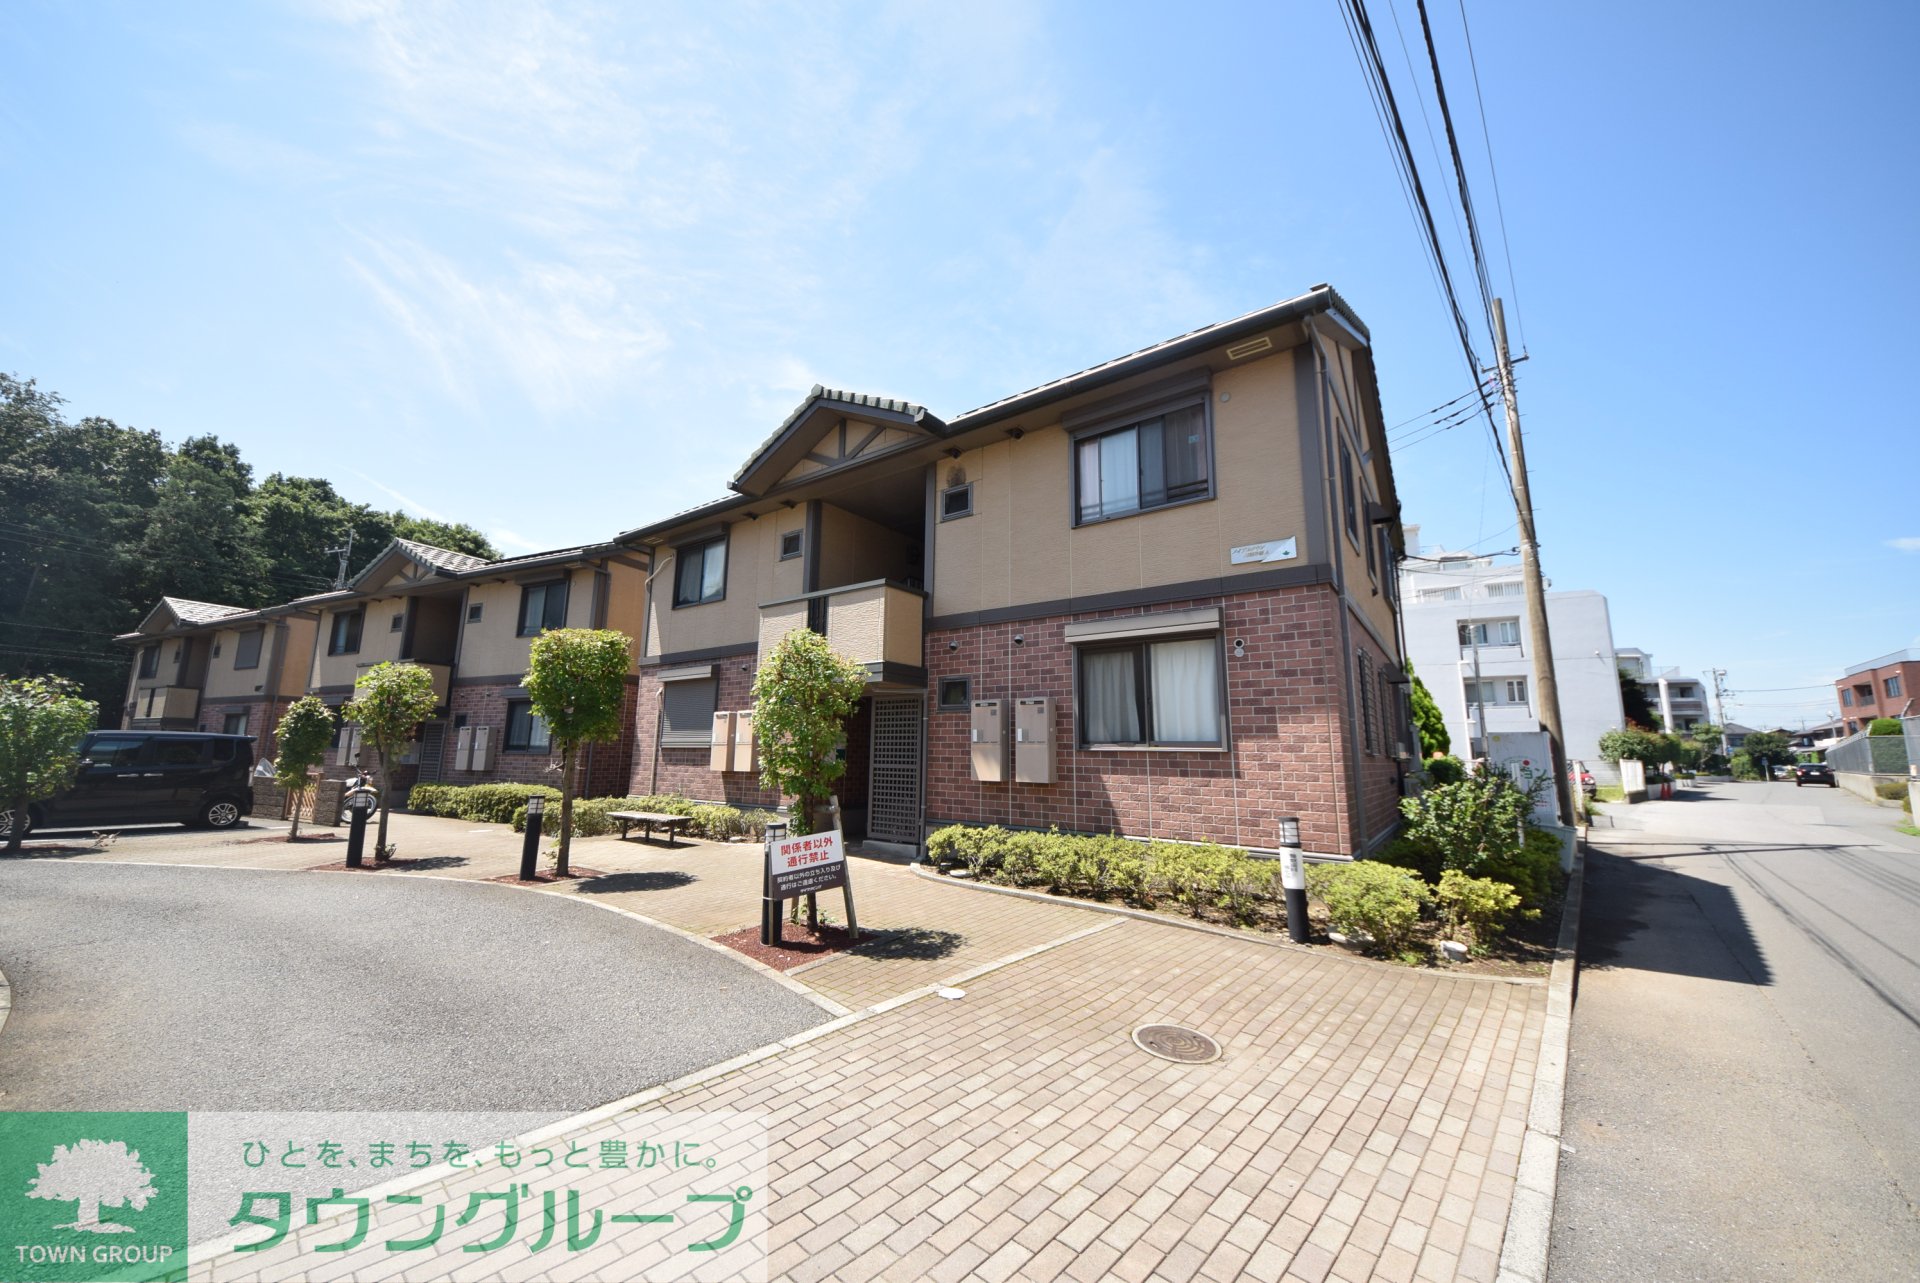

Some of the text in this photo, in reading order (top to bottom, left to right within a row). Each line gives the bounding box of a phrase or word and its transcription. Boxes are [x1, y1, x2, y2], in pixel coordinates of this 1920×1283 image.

[781, 837, 833, 856] 関係者以外
[787, 851, 829, 867] 通行禁止
[777, 864, 841, 884] 契約者以外の立ち入り及び
[780, 874, 837, 891] 通行はご遠慮ください。
